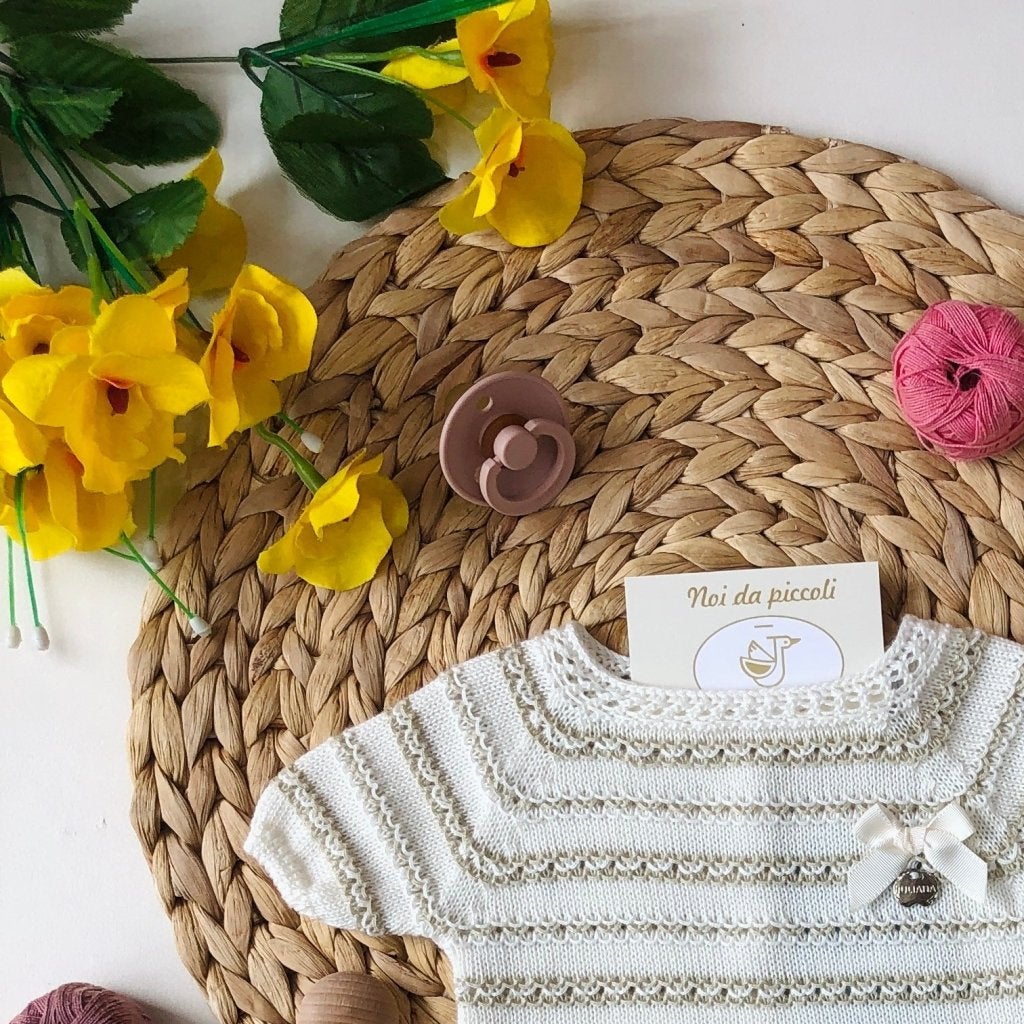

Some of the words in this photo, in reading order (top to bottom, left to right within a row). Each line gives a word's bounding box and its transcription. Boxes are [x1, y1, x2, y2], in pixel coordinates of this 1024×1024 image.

[687, 584, 728, 609] Noi
[731, 583, 762, 606] da
[766, 577, 838, 611] piccoli
